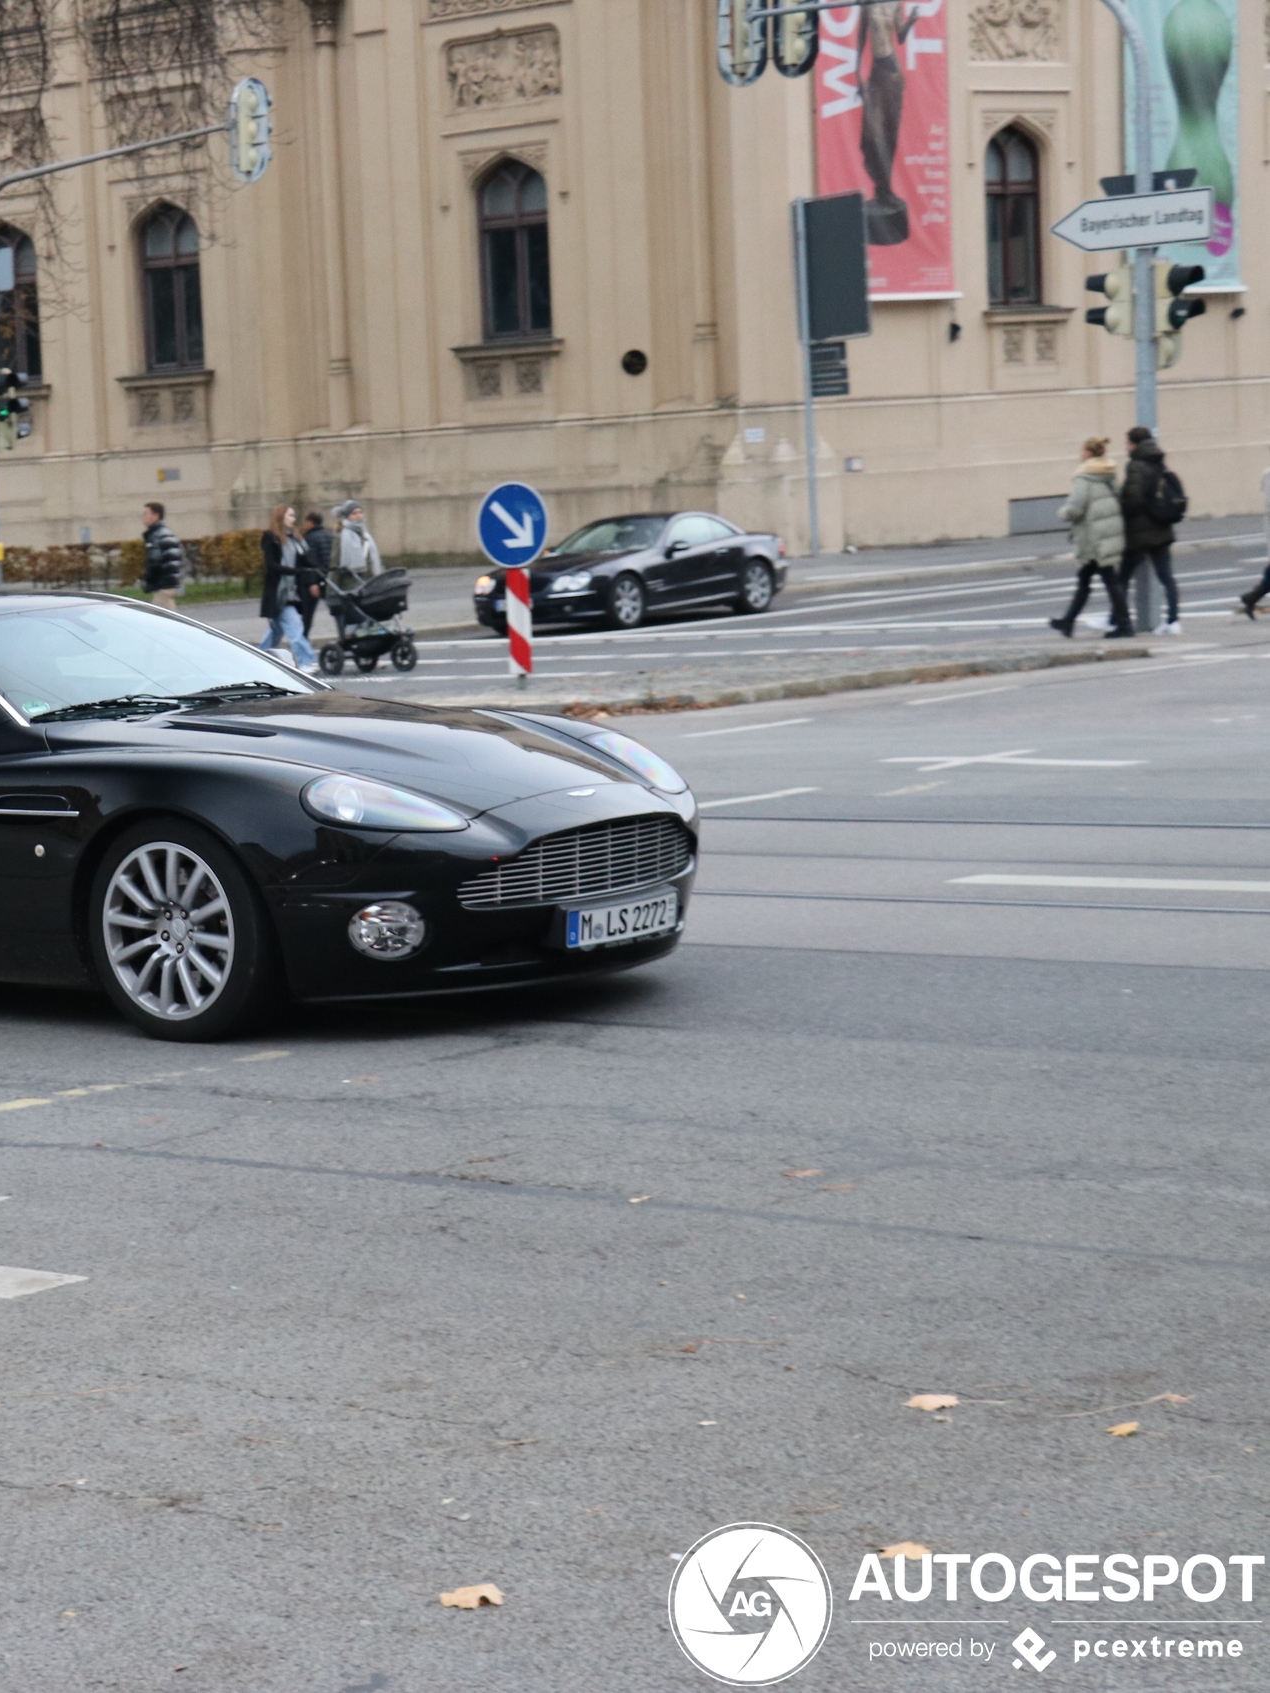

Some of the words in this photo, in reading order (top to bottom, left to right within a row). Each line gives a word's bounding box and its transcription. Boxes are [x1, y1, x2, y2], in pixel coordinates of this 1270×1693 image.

[1081, 213, 1150, 234] Bayerischer
[1155, 207, 1204, 225] Landtag
[581, 913, 593, 940] M
[632, 900, 667, 932] 2272
